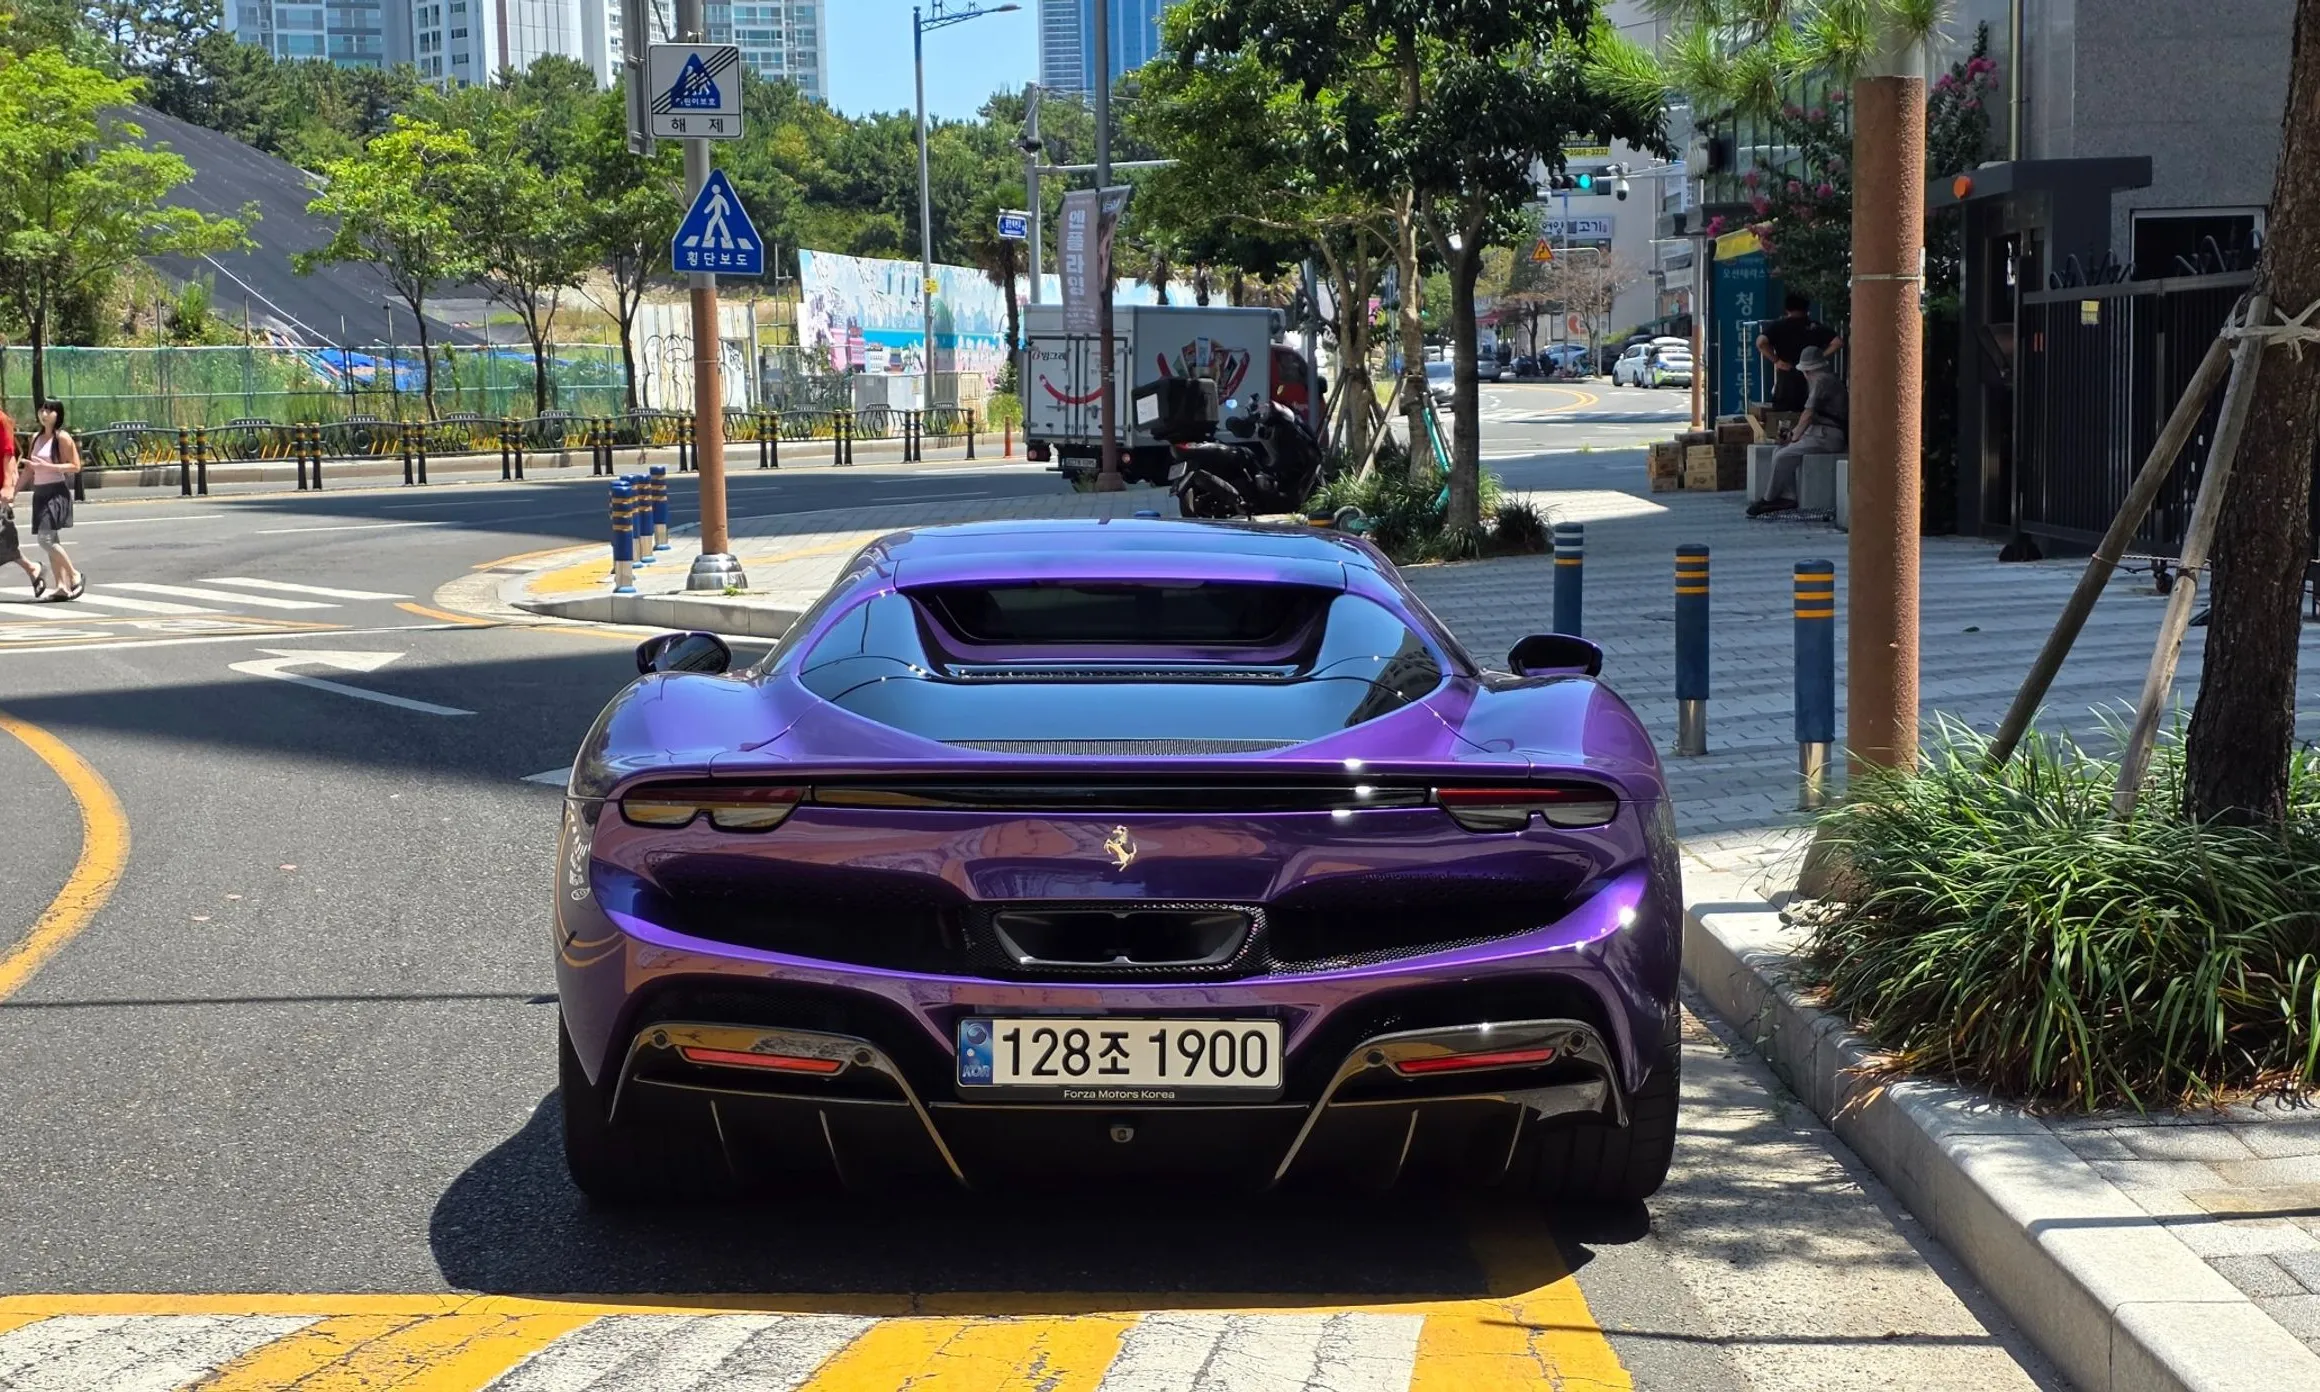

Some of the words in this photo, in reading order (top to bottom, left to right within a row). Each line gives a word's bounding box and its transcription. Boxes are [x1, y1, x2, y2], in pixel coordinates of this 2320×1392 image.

[686, 250, 748, 267] 횡단보도
[1002, 1027, 1130, 1077] 128조
[1148, 1028, 1268, 1079] 1900
[962, 1064, 990, 1079] KOR
[1063, 1089, 1096, 1099] Forza
[1098, 1089, 1139, 1099] Motors
[1141, 1089, 1175, 1099] Korea
